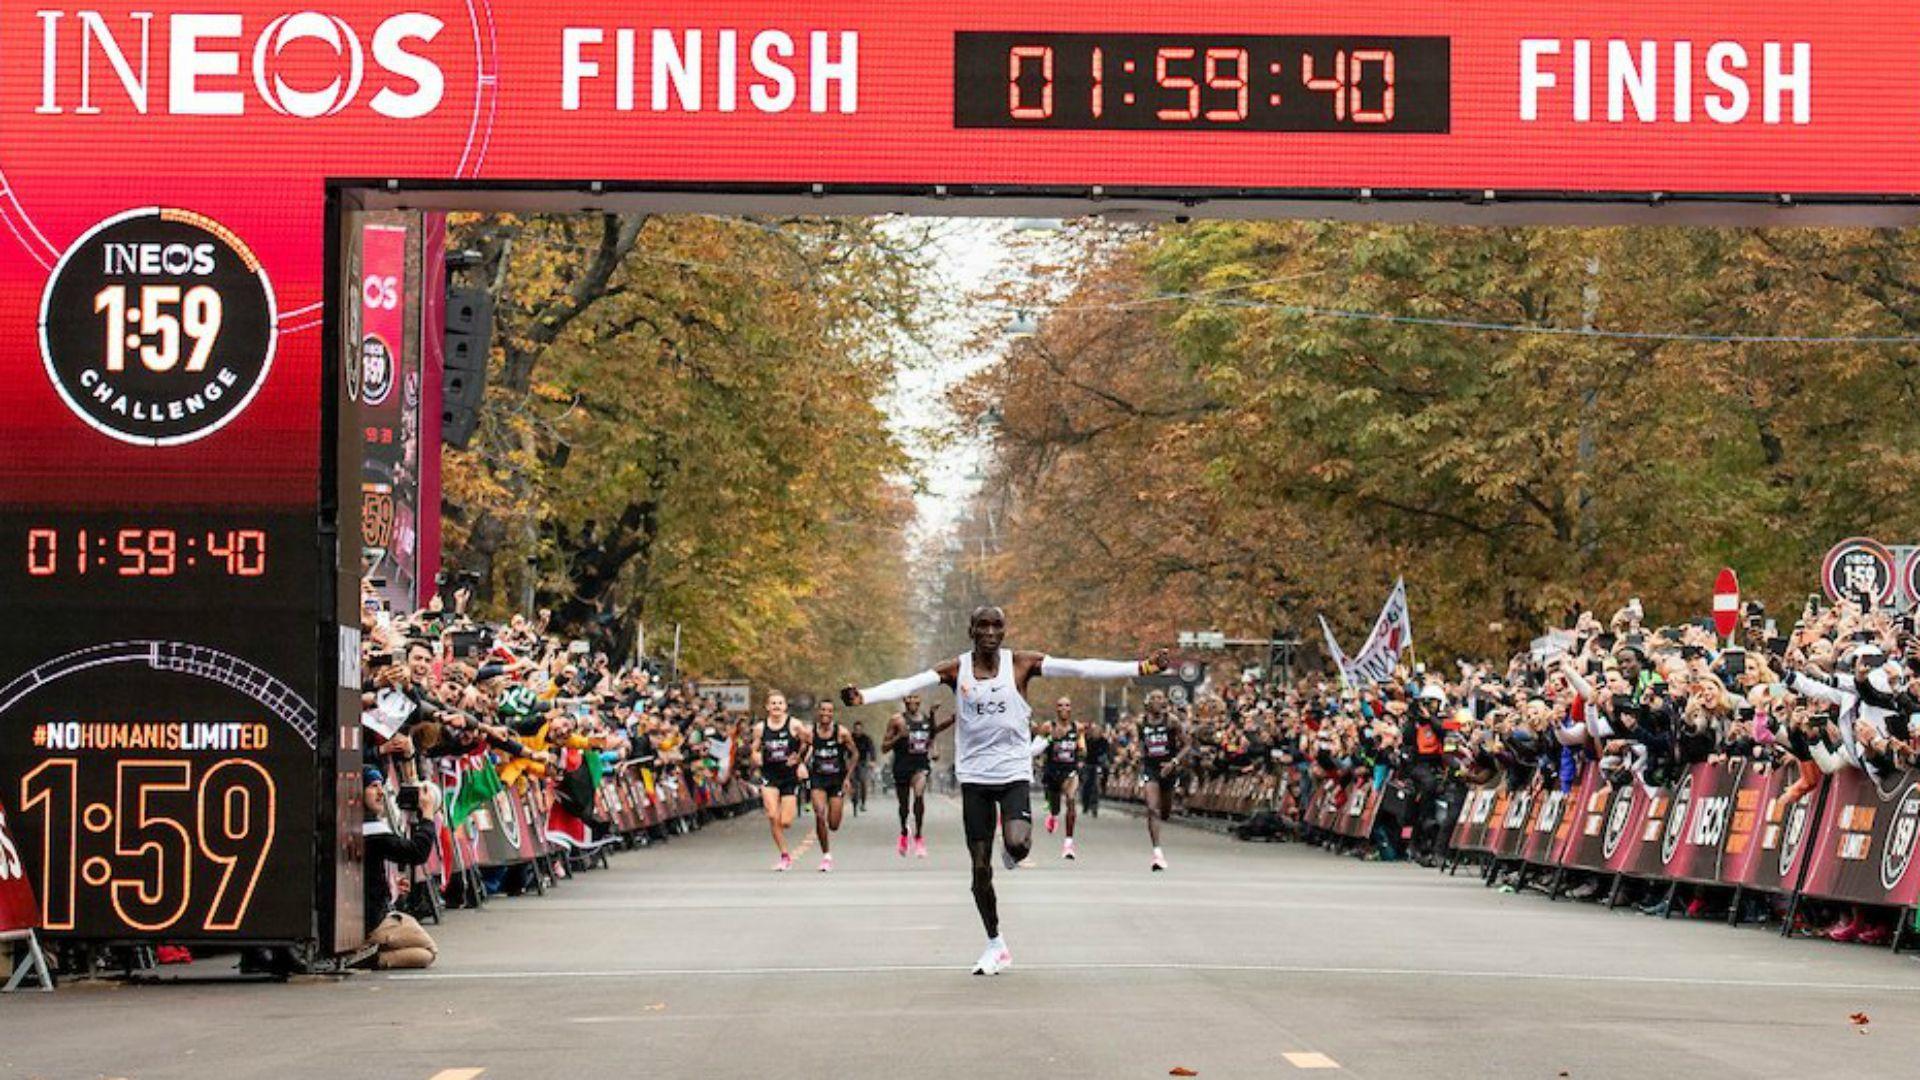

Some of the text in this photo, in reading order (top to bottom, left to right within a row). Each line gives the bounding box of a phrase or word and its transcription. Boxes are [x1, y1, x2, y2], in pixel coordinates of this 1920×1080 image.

[34, 10, 445, 118] INEOS
[561, 28, 858, 114] FINISH
[1008, 46, 1396, 122] 01:59:40
[1519, 39, 1811, 124] FINISH
[104, 243, 215, 275] INEOS
[94, 285, 222, 371] 1:59
[80, 367, 237, 421] CHALLENGE
[27, 529, 266, 576] 01:59:40
[33, 722, 268, 750] #NOHUMANISLIMITED
[20, 758, 276, 931] 1:59
